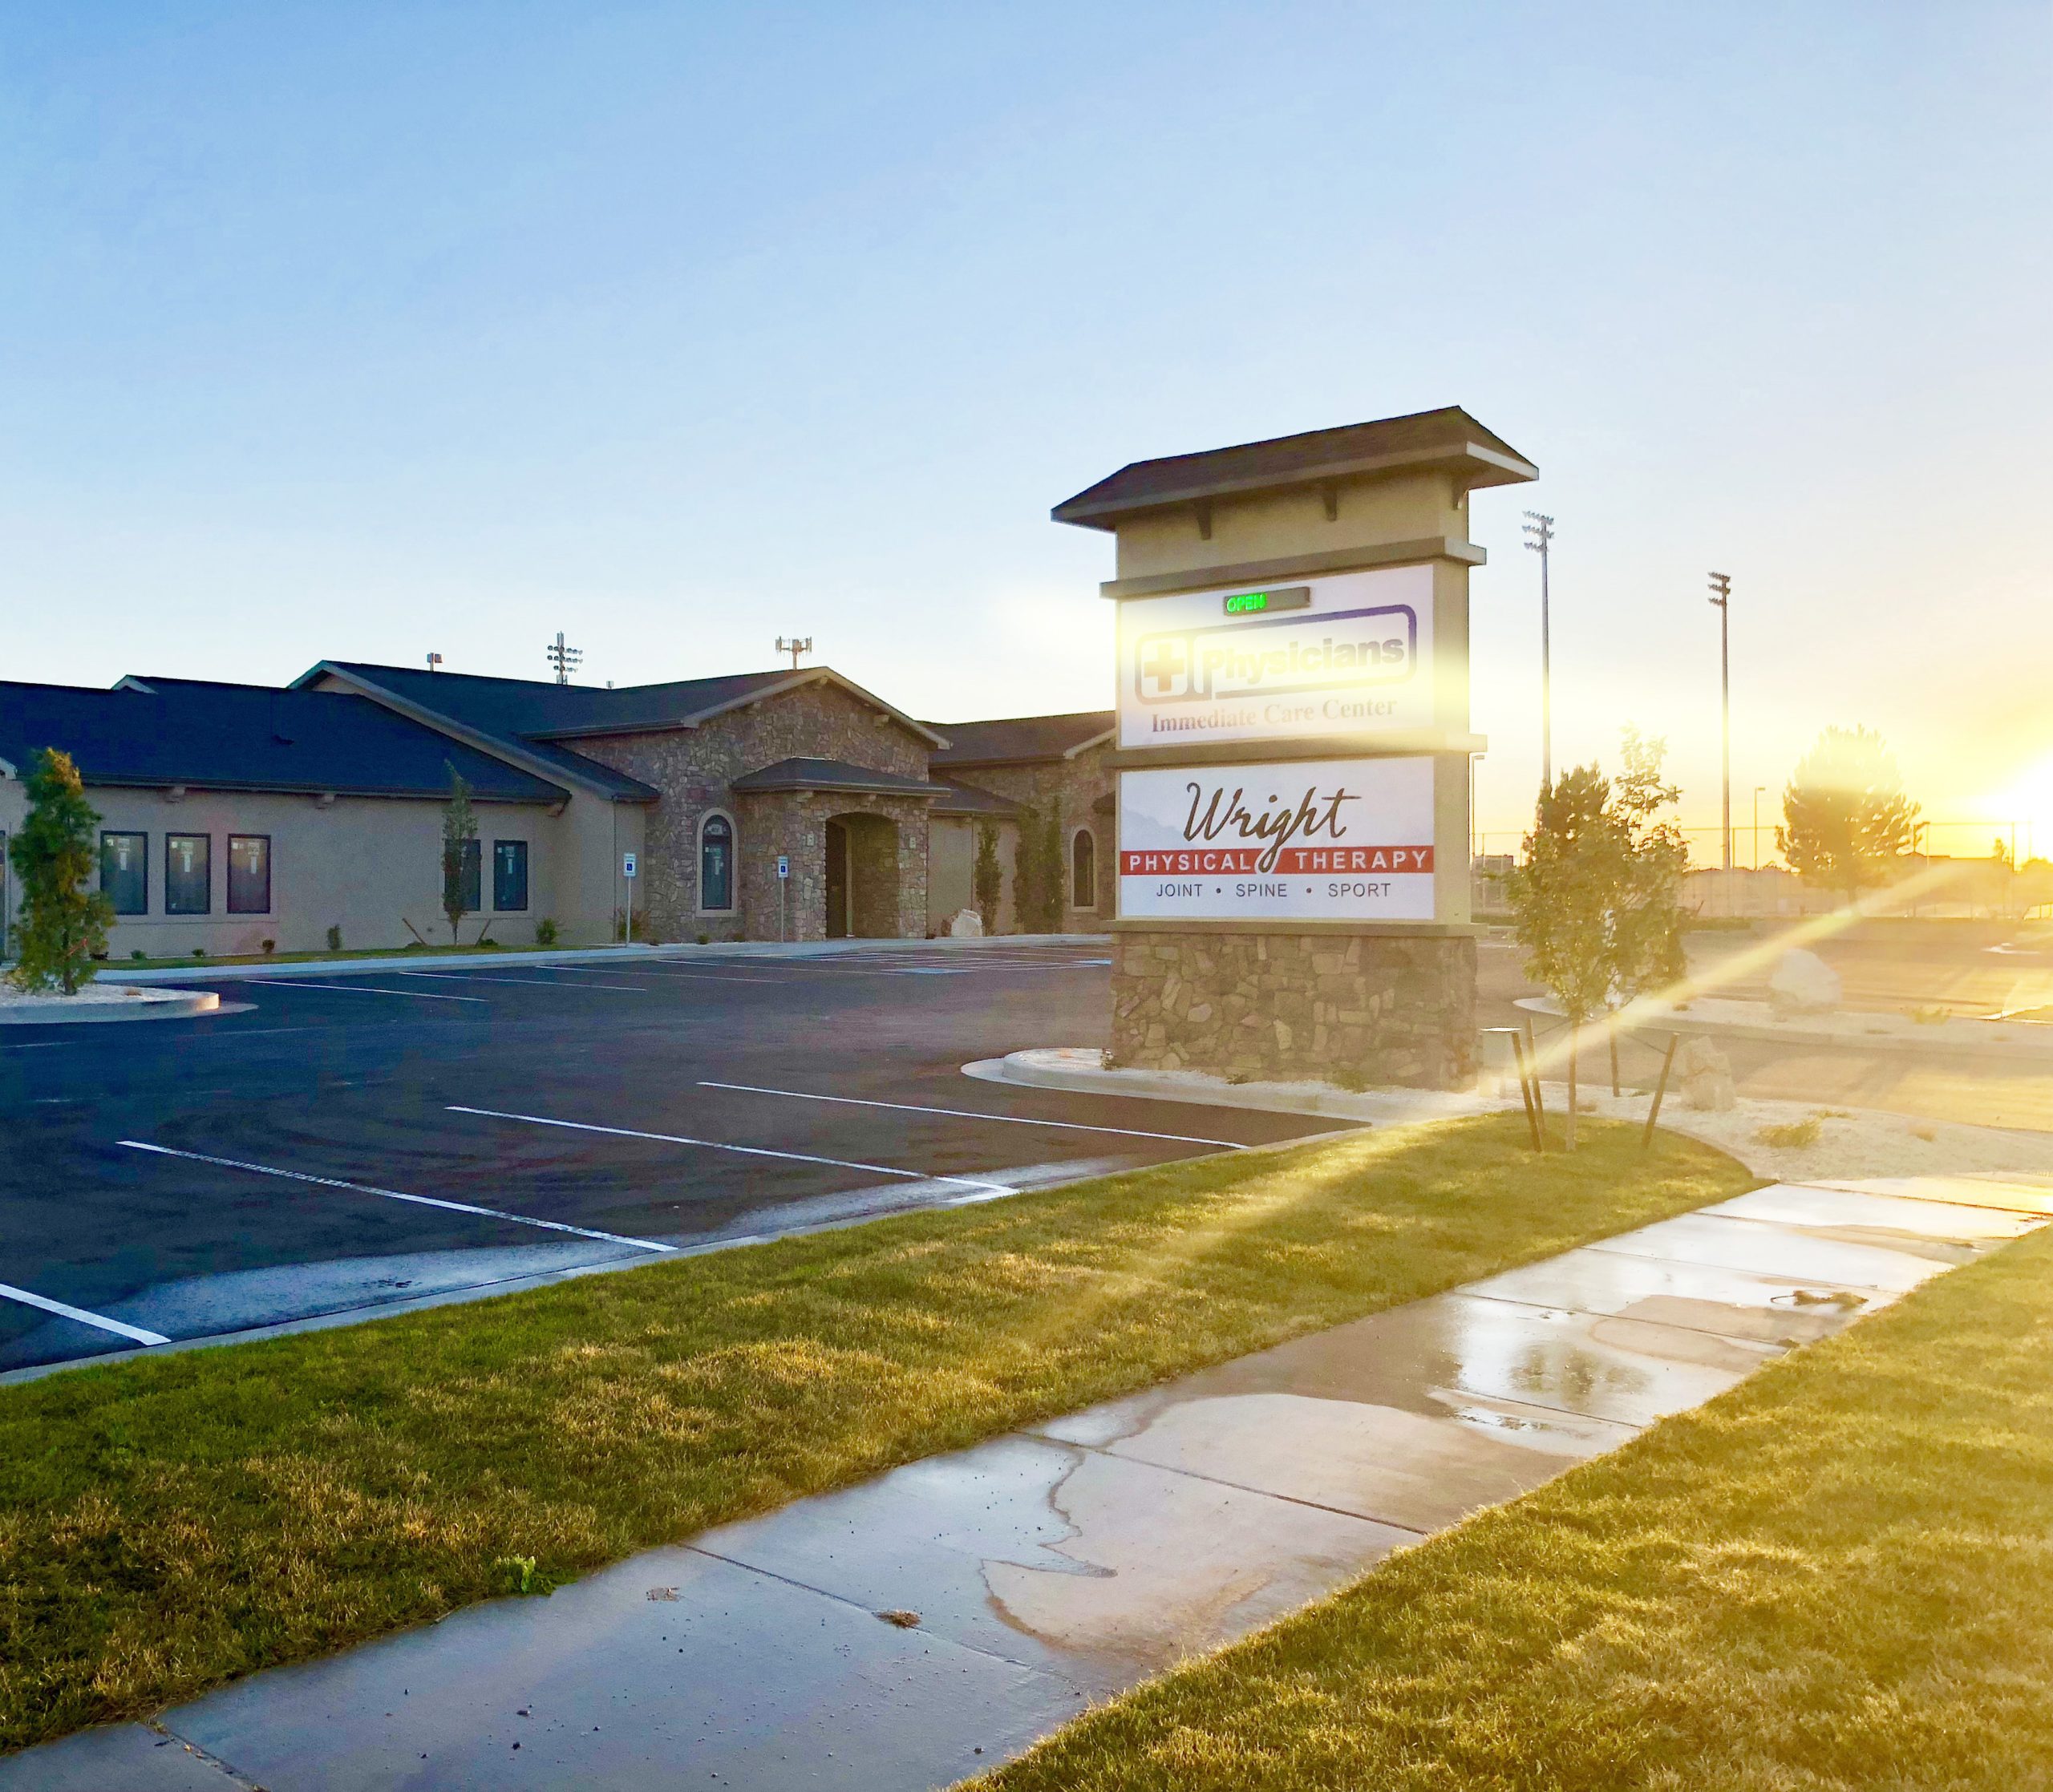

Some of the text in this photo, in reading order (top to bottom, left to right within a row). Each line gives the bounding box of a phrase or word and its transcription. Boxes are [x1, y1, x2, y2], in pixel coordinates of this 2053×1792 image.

[1226, 593, 1266, 613] OPEN
[1204, 637, 1405, 686] Physicians
[1152, 698, 1397, 733] Immediate Care Center
[1183, 782, 1362, 874] Wright
[1129, 850, 1427, 872] PHYSICAL THERAPY
[1156, 883, 1391, 898] JOINT SPINE SPORT
